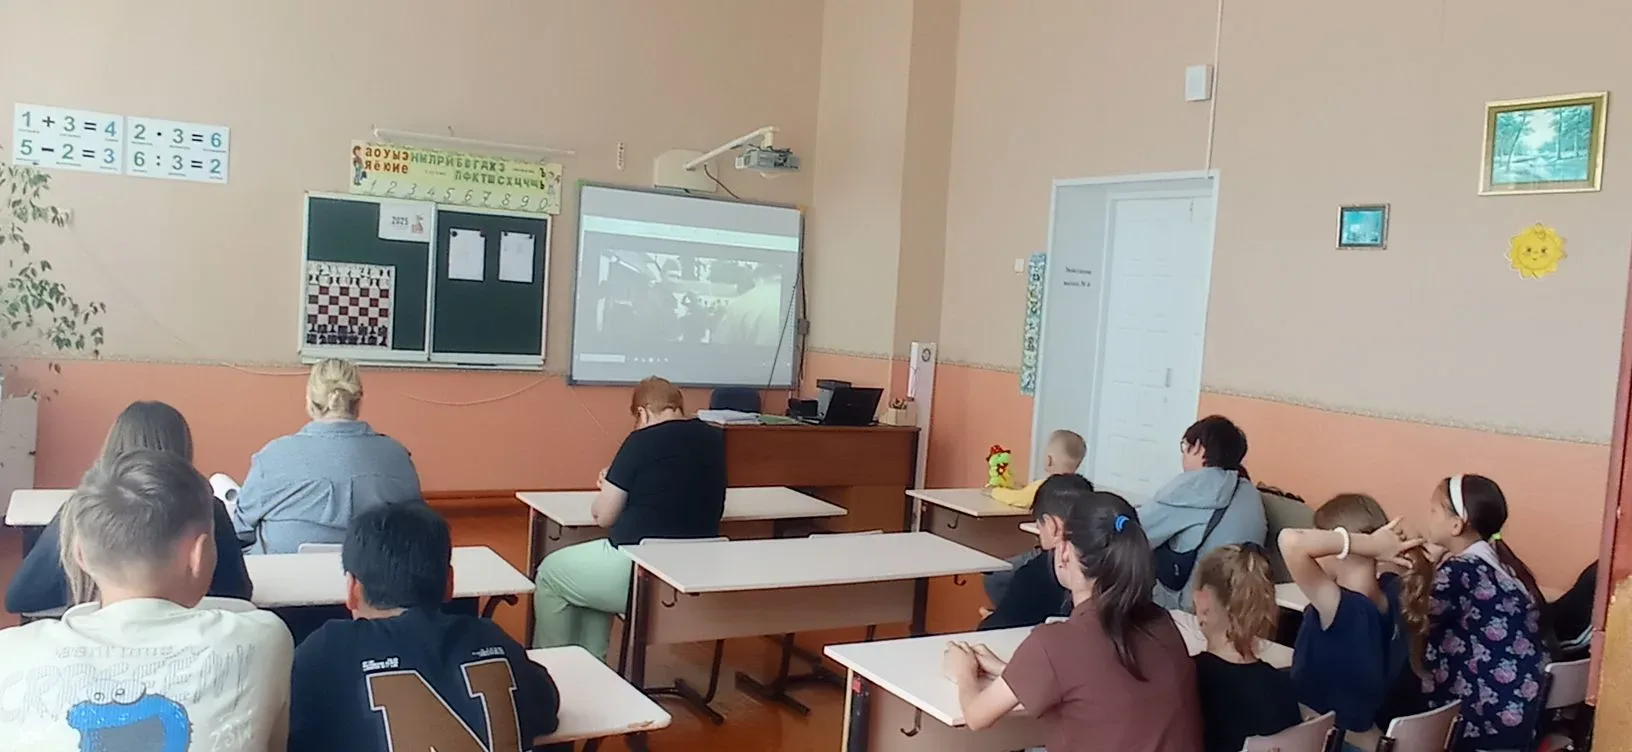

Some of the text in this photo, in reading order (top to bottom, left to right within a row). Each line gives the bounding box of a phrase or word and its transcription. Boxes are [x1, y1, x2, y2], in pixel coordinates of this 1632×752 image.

[22, 111, 116, 136] 1 + 3 = 4
[134, 124, 146, 140] 2
[172, 128, 184, 144] 3
[192, 134, 204, 142] =
[210, 132, 222, 148] 6
[20, 139, 32, 155] 5
[62, 144, 74, 160] 2
[82, 149, 95, 158] =
[104, 148, 115, 164] 3
[134, 151, 145, 166] 6
[172, 154, 184, 170] 3
[190, 160, 203, 168] =
[210, 158, 221, 174] 2
[386, 180, 398, 194] 2
[408, 183, 417, 196] 3
[426, 186, 436, 197] 4
[444, 187, 455, 200] 5
[464, 188, 474, 202] 6
[482, 190, 492, 202] 7
[502, 192, 511, 206] 8
[521, 194, 530, 206] 9
[539, 197, 548, 210] 0
[392, 215, 409, 226] 2025
